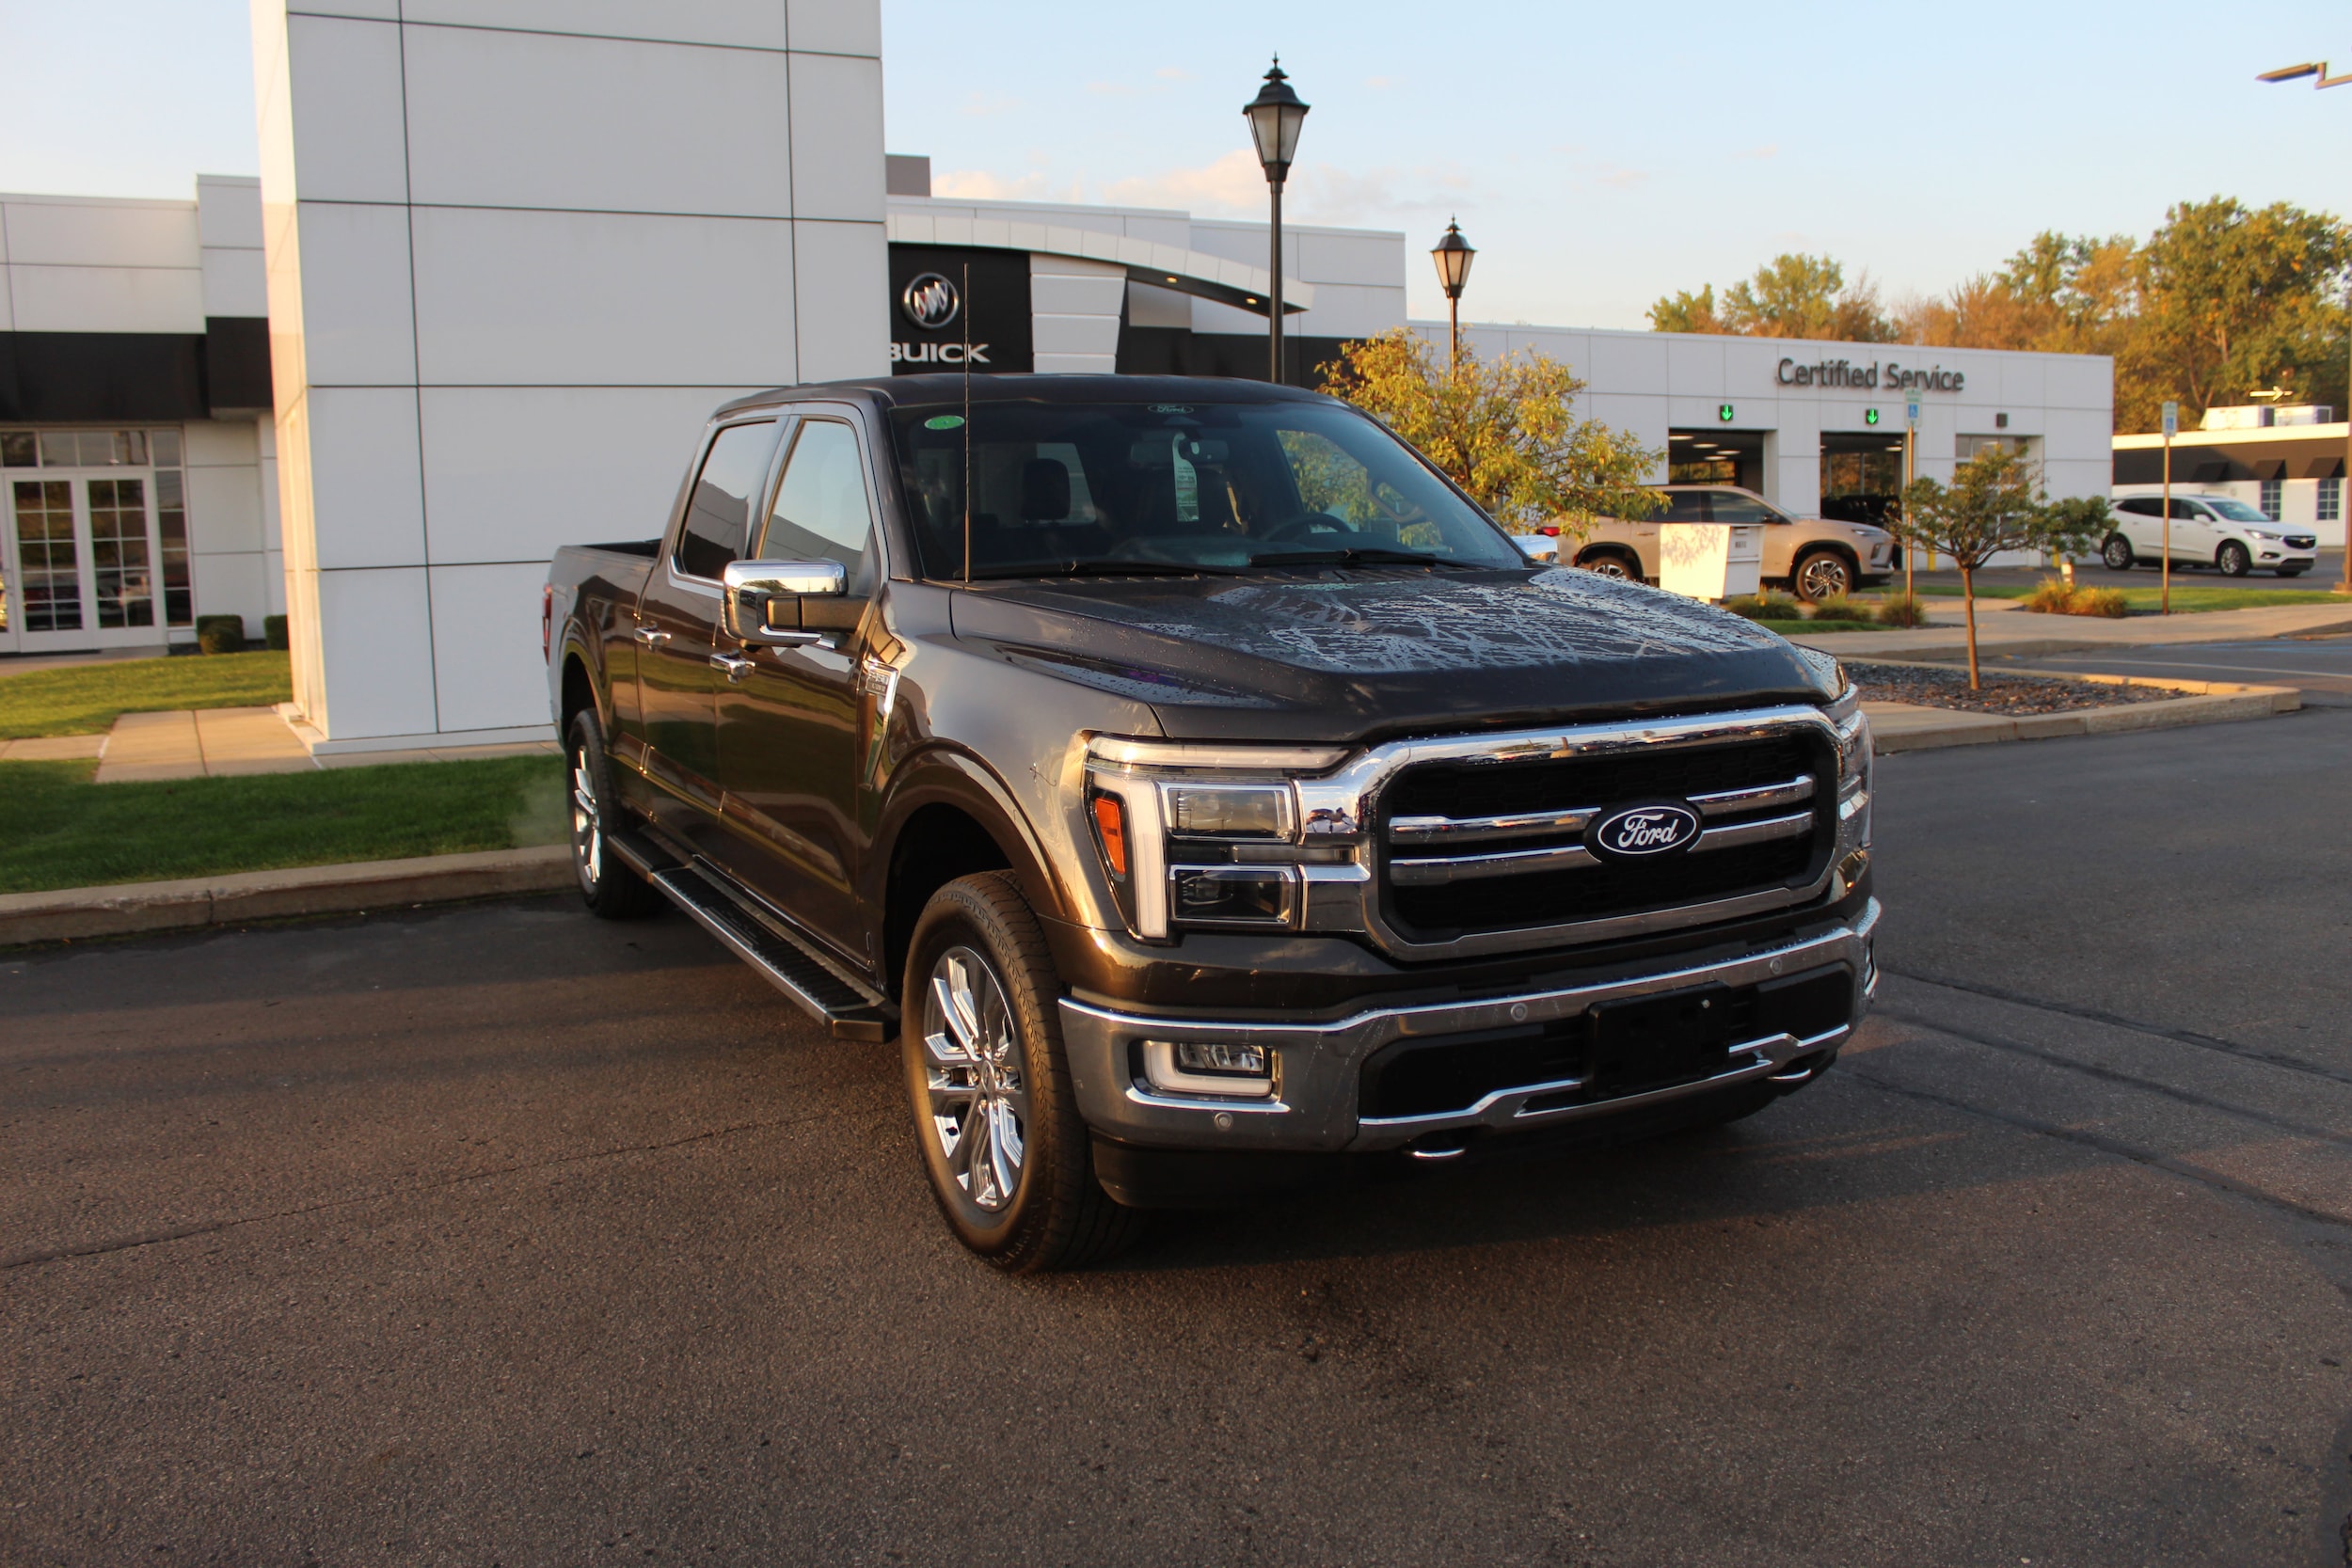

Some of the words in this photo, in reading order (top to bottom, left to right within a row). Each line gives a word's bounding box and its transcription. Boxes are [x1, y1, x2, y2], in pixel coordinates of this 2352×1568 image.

[1777, 357, 1878, 388] Certified
[1886, 362, 1964, 391] Service
[1617, 814, 1679, 847] Ford
